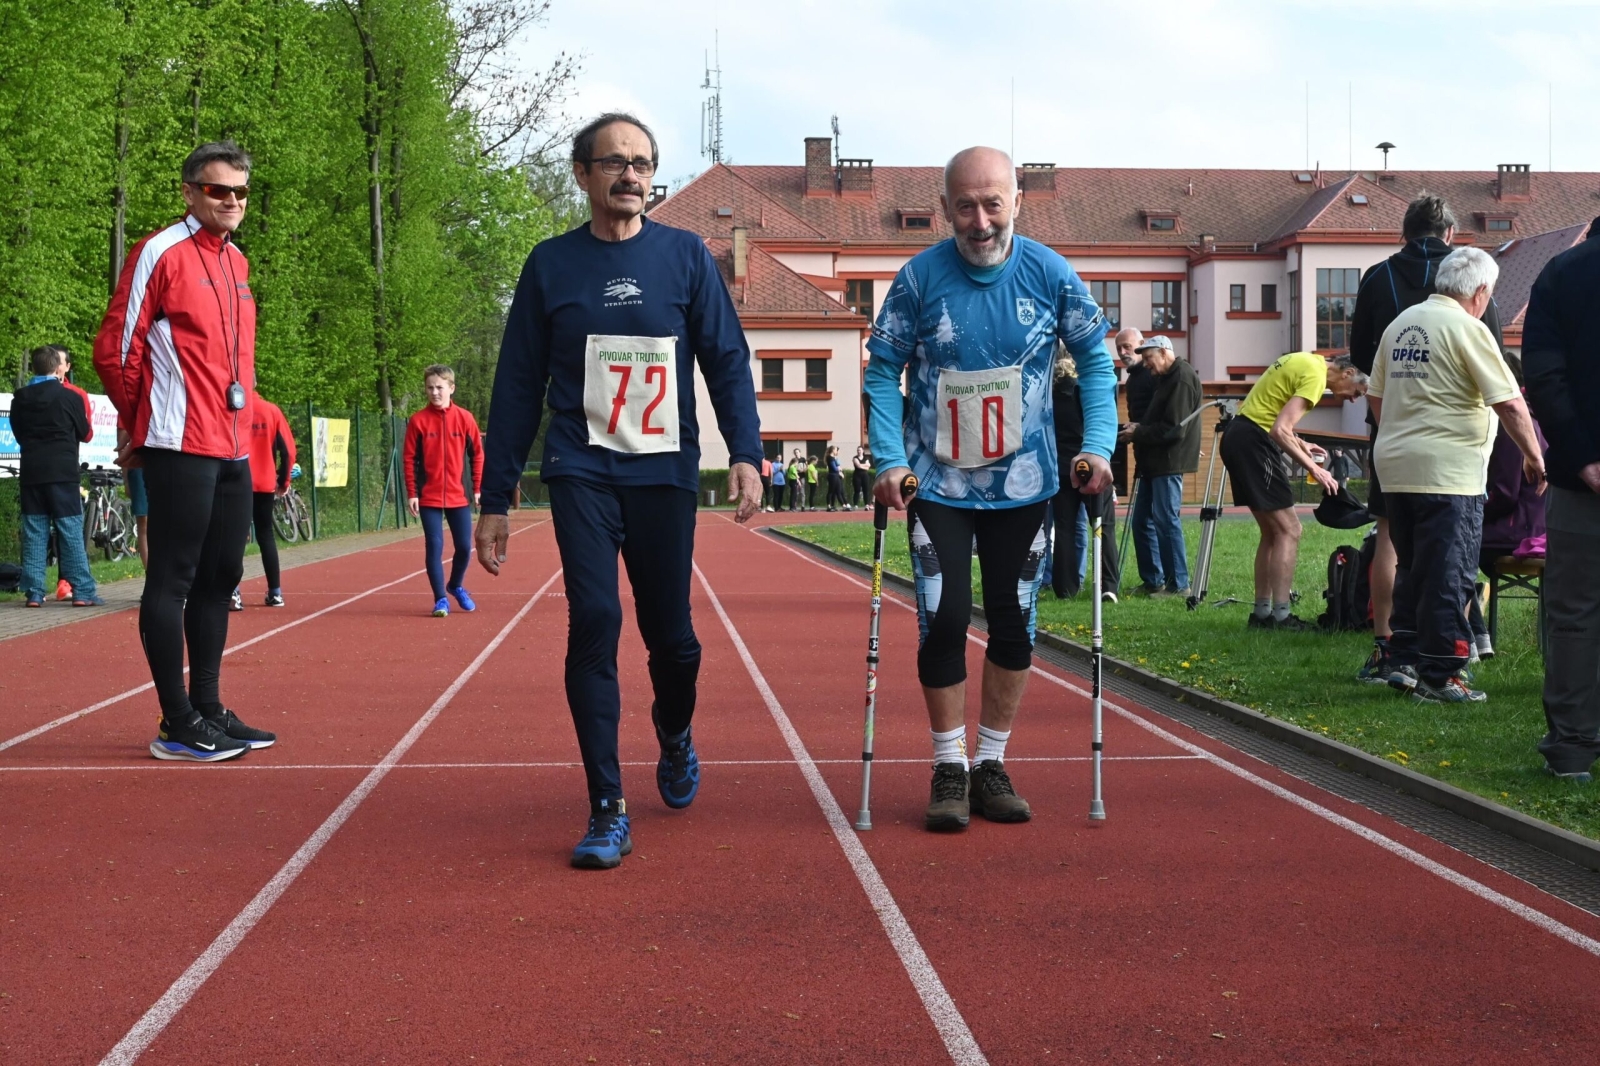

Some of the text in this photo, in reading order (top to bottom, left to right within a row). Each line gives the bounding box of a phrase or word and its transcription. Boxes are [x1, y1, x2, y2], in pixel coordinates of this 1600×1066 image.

[606, 277, 637, 286] NEVADA
[599, 351, 668, 363] PIVOVAR TRUTNOV
[945, 380, 1010, 395] PIVOVAR TRUTNOV
[607, 366, 666, 434] 72
[947, 396, 1003, 460] 10
